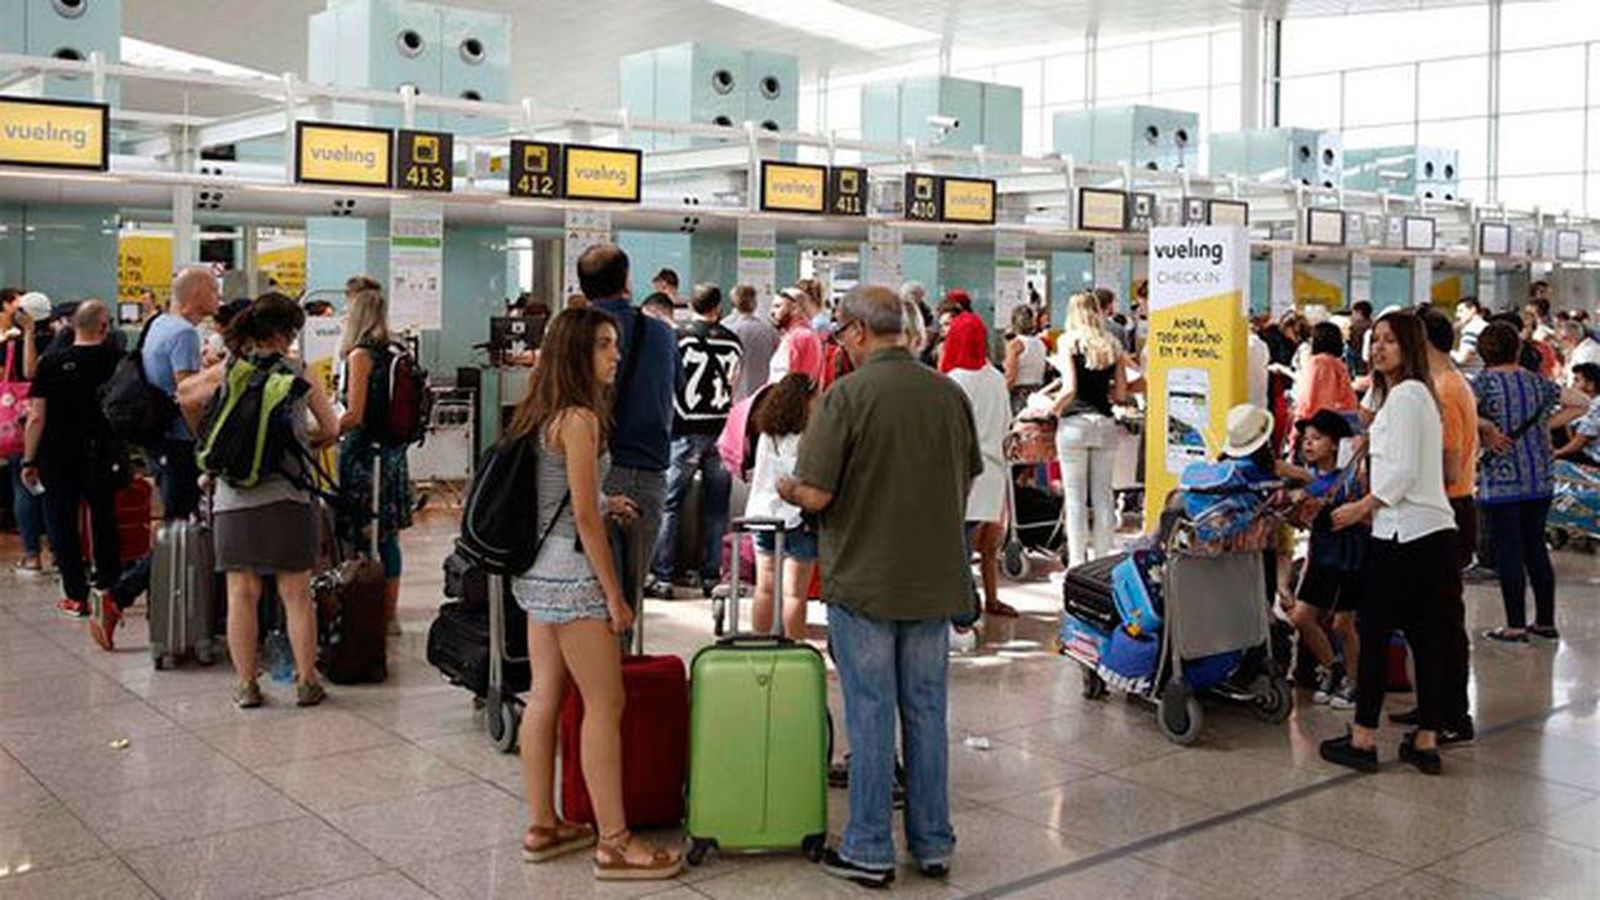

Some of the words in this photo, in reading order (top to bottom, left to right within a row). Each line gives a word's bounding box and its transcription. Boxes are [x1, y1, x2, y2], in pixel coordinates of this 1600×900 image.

[4, 120, 87, 149] vueling
[310, 143, 377, 169] vueling
[405, 166, 445, 187] 413
[517, 174, 555, 195] 412
[574, 164, 628, 186] vueling
[836, 195, 860, 213] 411
[910, 201, 936, 218] 410
[1154, 237, 1224, 265] vueling
[1173, 318, 1207, 330] AHORA
